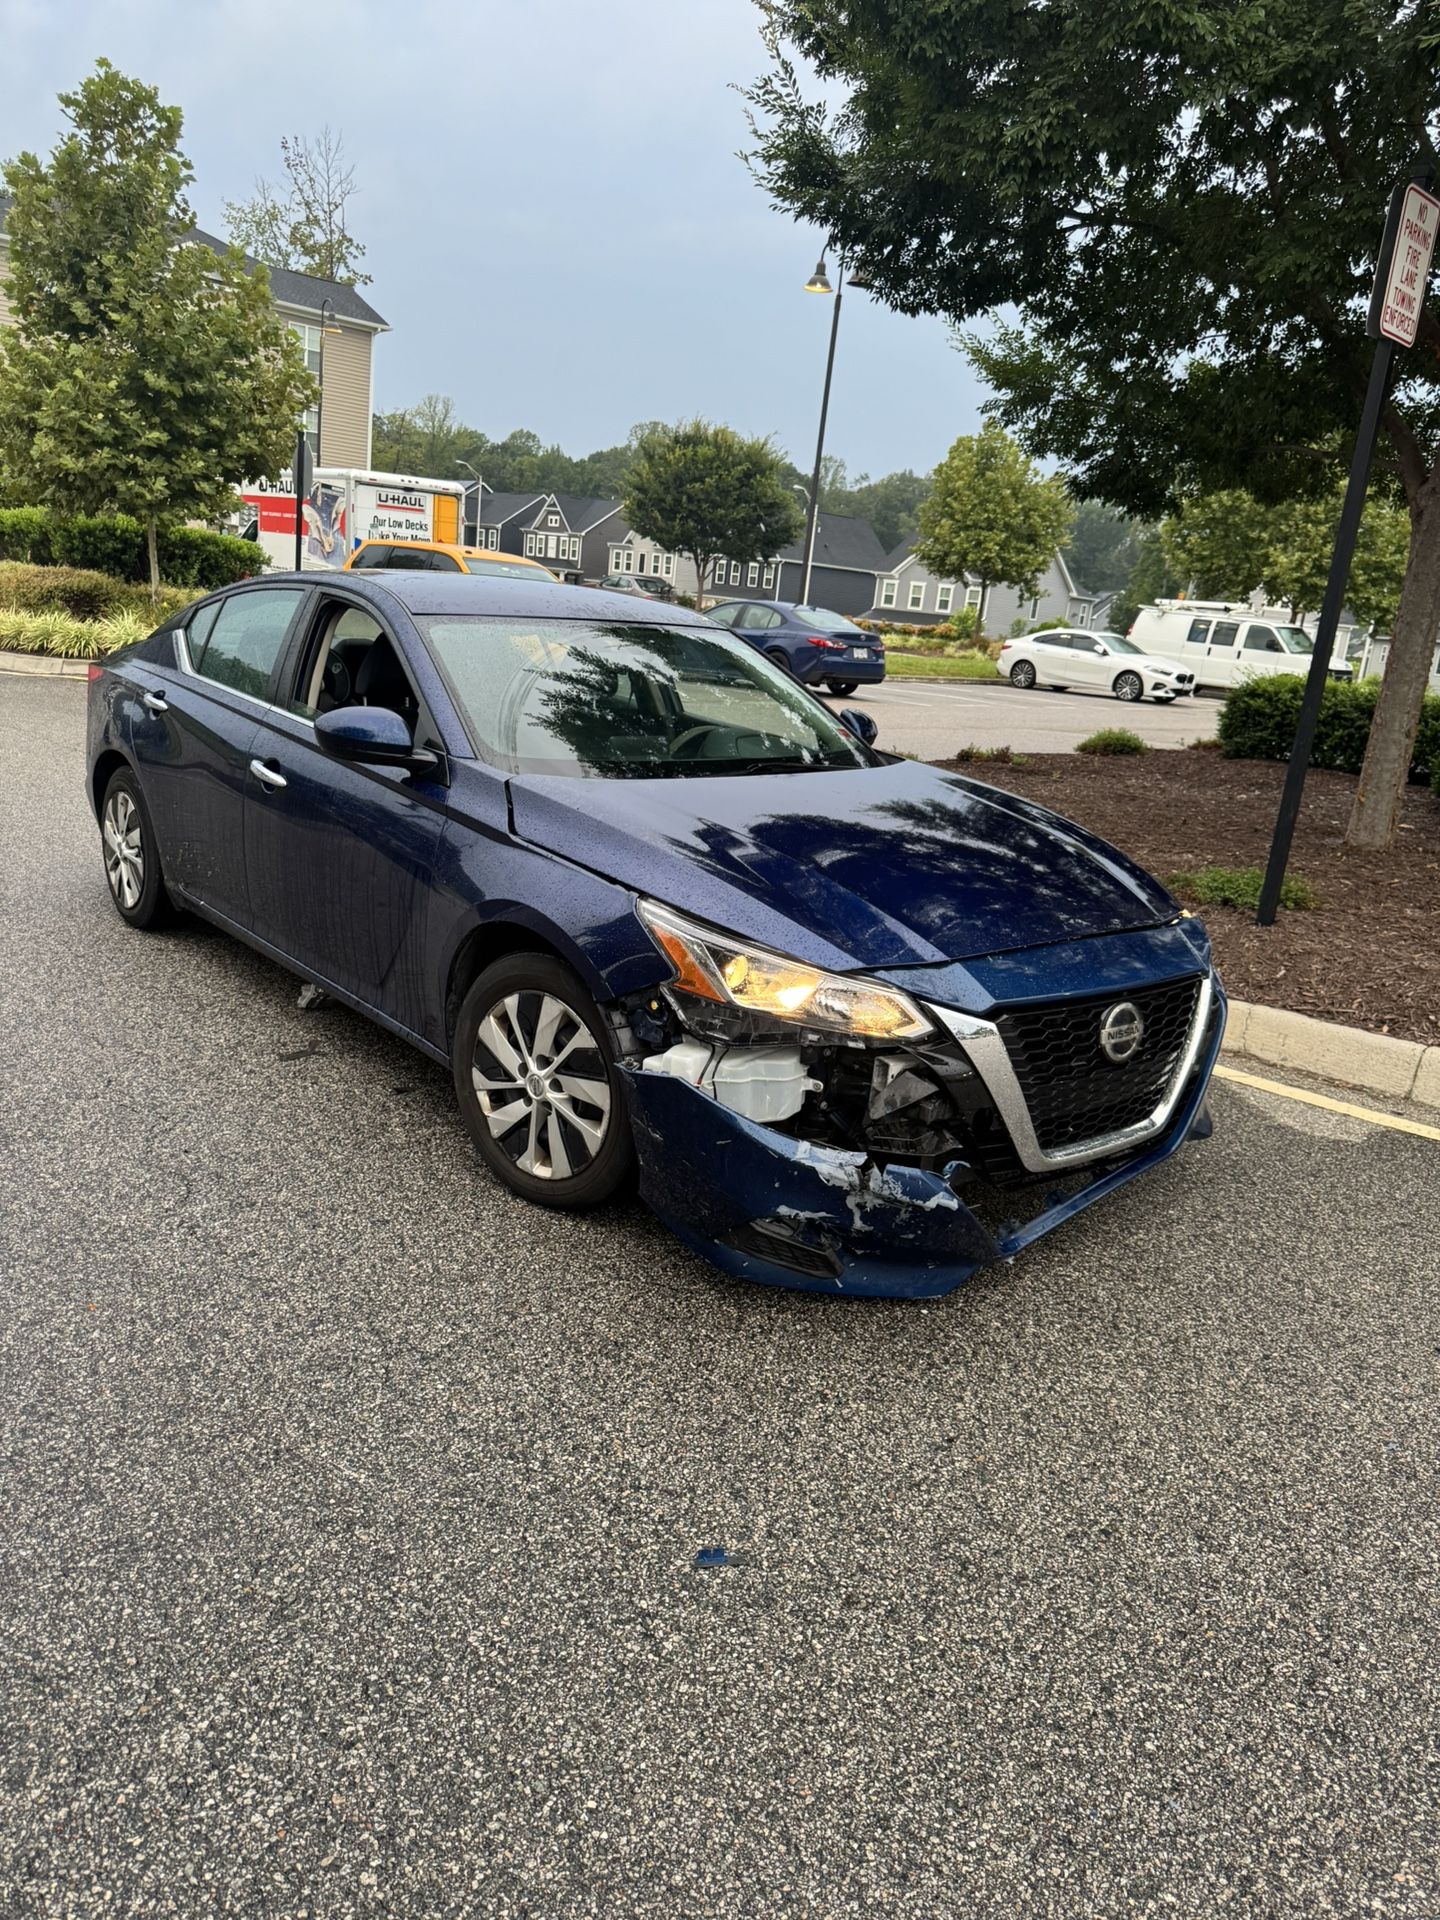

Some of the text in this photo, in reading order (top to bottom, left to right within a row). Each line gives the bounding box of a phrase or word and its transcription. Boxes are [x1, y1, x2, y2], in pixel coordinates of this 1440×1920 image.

[1416, 202, 1429, 224] NO
[1404, 218, 1432, 250] PARKING
[1405, 245, 1422, 269] FIRE
[1400, 267, 1418, 290] LANE
[1392, 286, 1417, 315] TOWING
[1383, 305, 1417, 337] ENFORCED
[378, 492, 424, 508] U-HAUL
[373, 515, 429, 532] Our Low Decks
[1107, 1024, 1140, 1040] NISSAN
